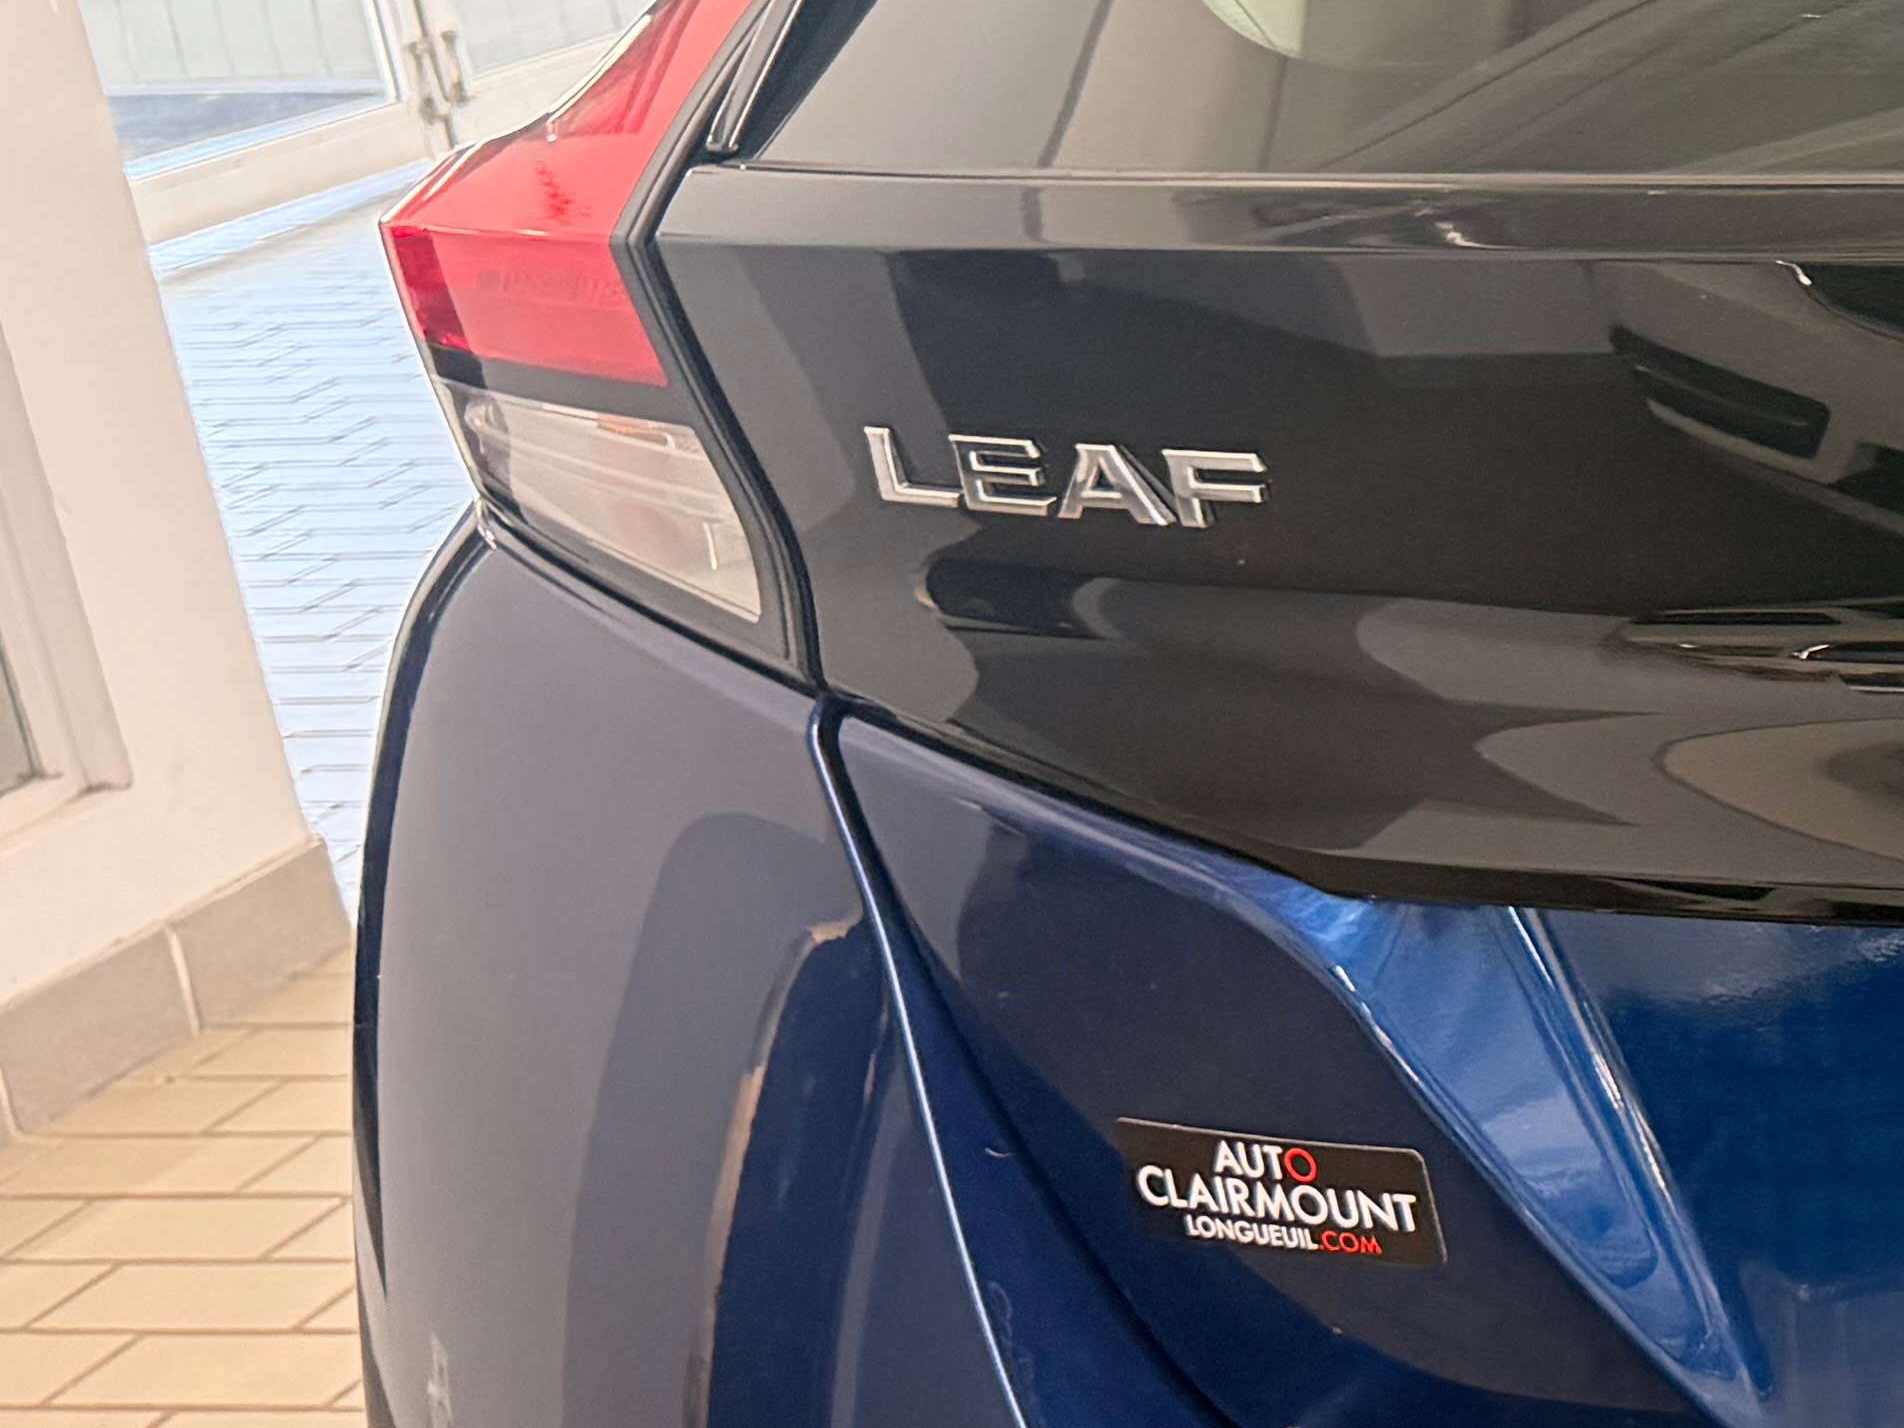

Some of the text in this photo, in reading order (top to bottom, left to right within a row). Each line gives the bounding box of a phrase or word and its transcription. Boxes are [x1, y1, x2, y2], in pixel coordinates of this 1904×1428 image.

[863, 425, 1268, 529] LEAF
[1214, 1139, 1318, 1184] AUTO
[1136, 1164, 1418, 1233] CLAIRMOUNT
[1185, 1213, 1383, 1255] LONGUEUIL.COM
